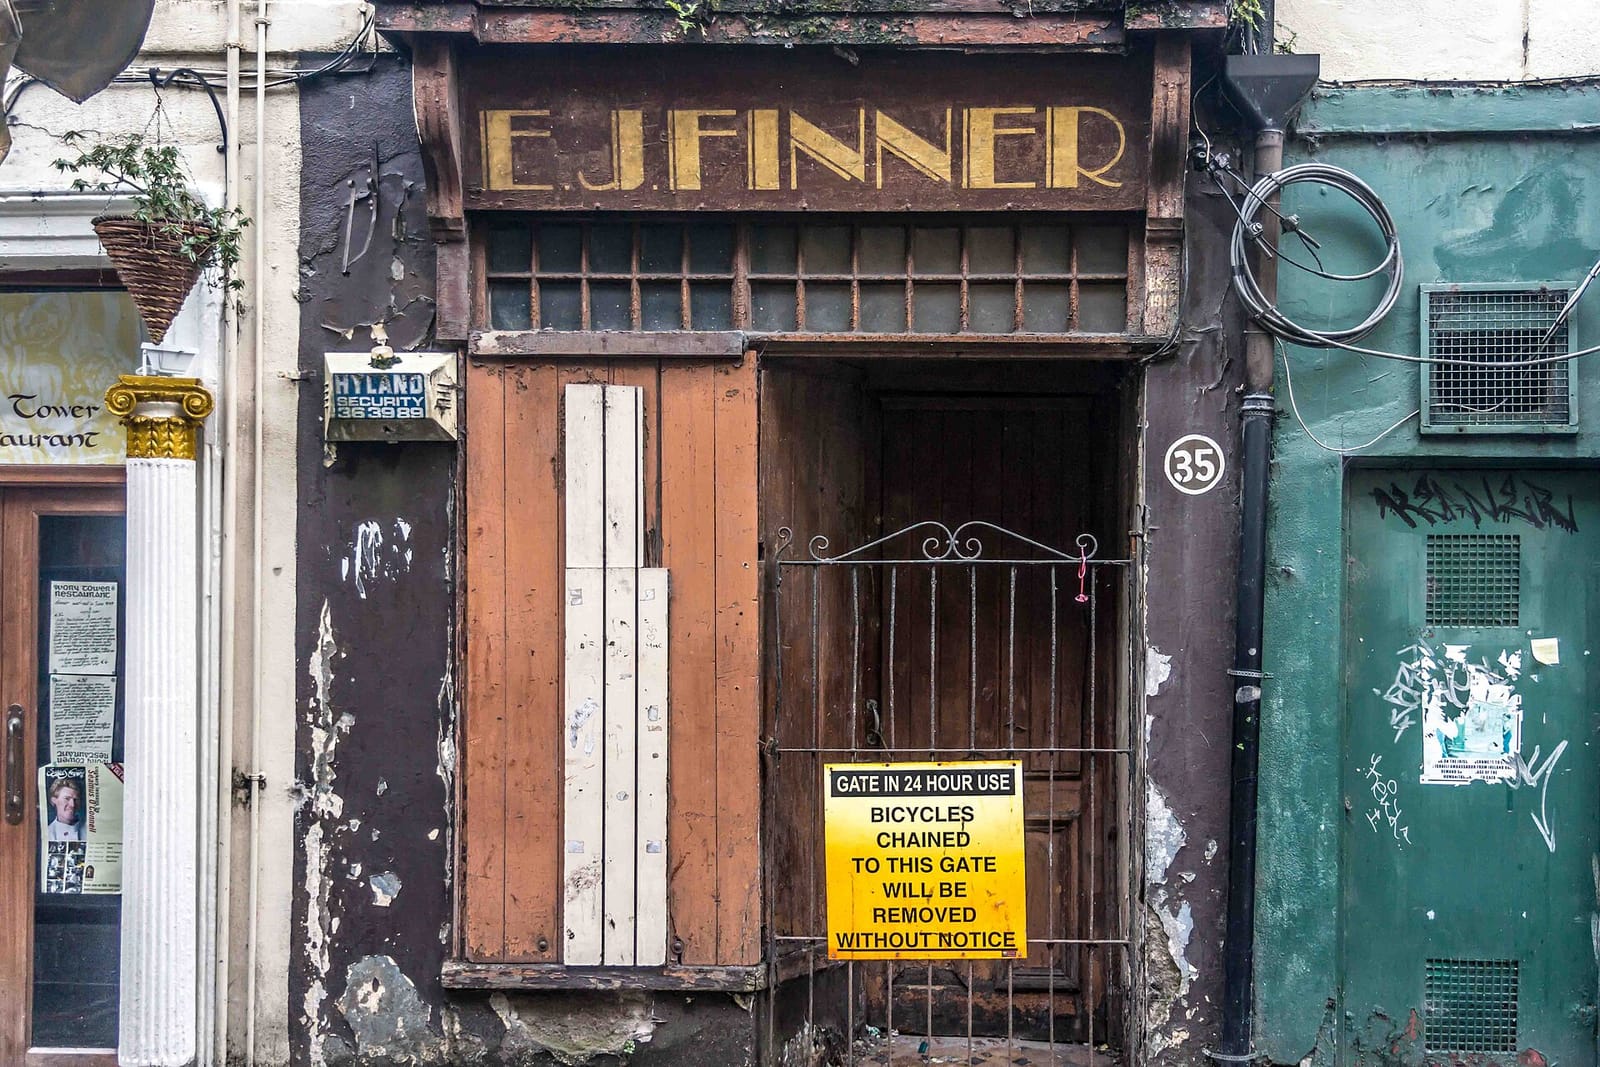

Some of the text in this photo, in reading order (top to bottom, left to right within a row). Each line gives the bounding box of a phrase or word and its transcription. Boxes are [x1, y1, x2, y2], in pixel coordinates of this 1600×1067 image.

[335, 374, 423, 394] HYLAND
[8, 394, 100, 419] Tower
[337, 396, 424, 407] SECURITY
[1173, 448, 1215, 483] 35
[837, 773, 1010, 793] GATE IN 24 HOUR USE
[870, 805, 975, 823] BICYCLES
[876, 831, 971, 849] CHAINED
[851, 856, 997, 874] TO THIS GATE
[882, 882, 968, 898] WILL BE
[873, 907, 977, 924] REMOVED
[836, 931, 1016, 948] WITHOUT NOTICE
